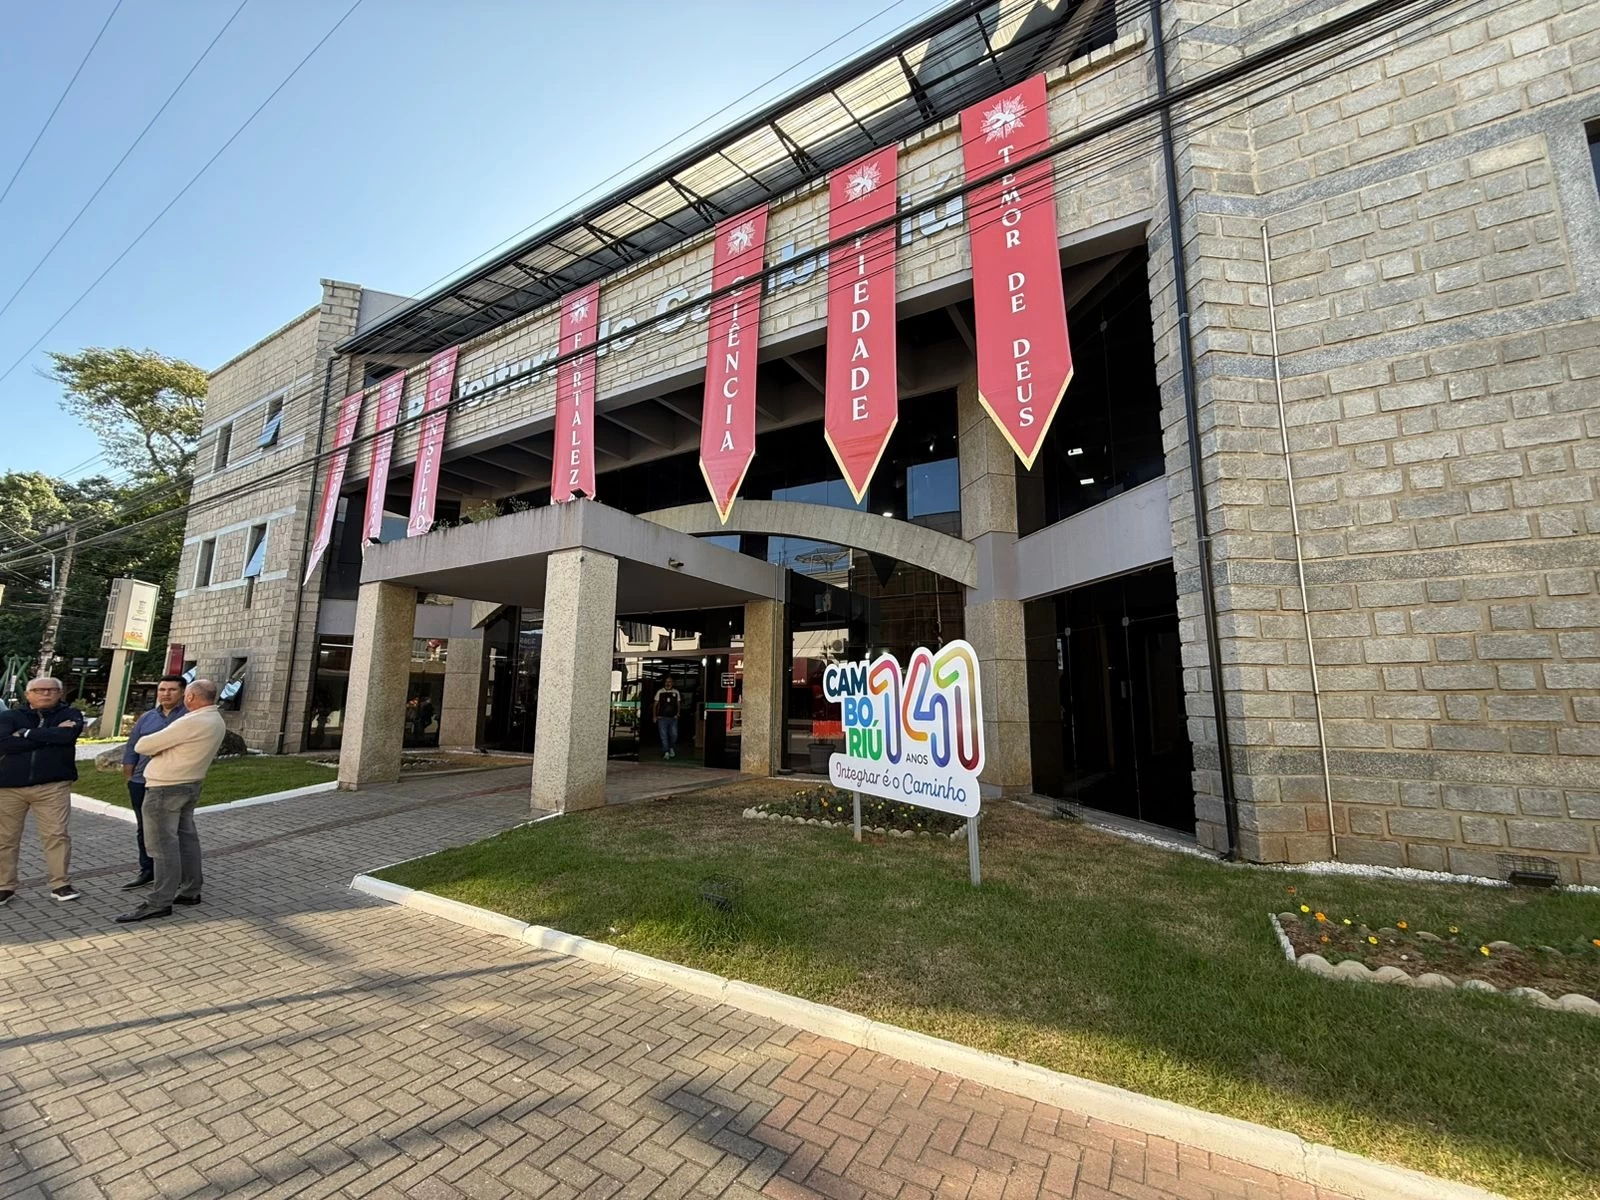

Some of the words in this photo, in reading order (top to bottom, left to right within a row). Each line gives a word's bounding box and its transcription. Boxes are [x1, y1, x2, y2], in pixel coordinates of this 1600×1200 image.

[997, 145, 1021, 249] TEMOR
[1008, 272, 1026, 314] DE
[1012, 338, 1035, 428] DEUS
[826, 666, 867, 697] CAM
[844, 697, 873, 728] BO
[868, 646, 980, 771] 141
[850, 719, 882, 761] RIÚ
[905, 753, 928, 766] ANOS
[836, 761, 880, 787] Integrar
[882, 768, 892, 787] é
[892, 777, 900, 789] o
[902, 772, 967, 803] Caminho
